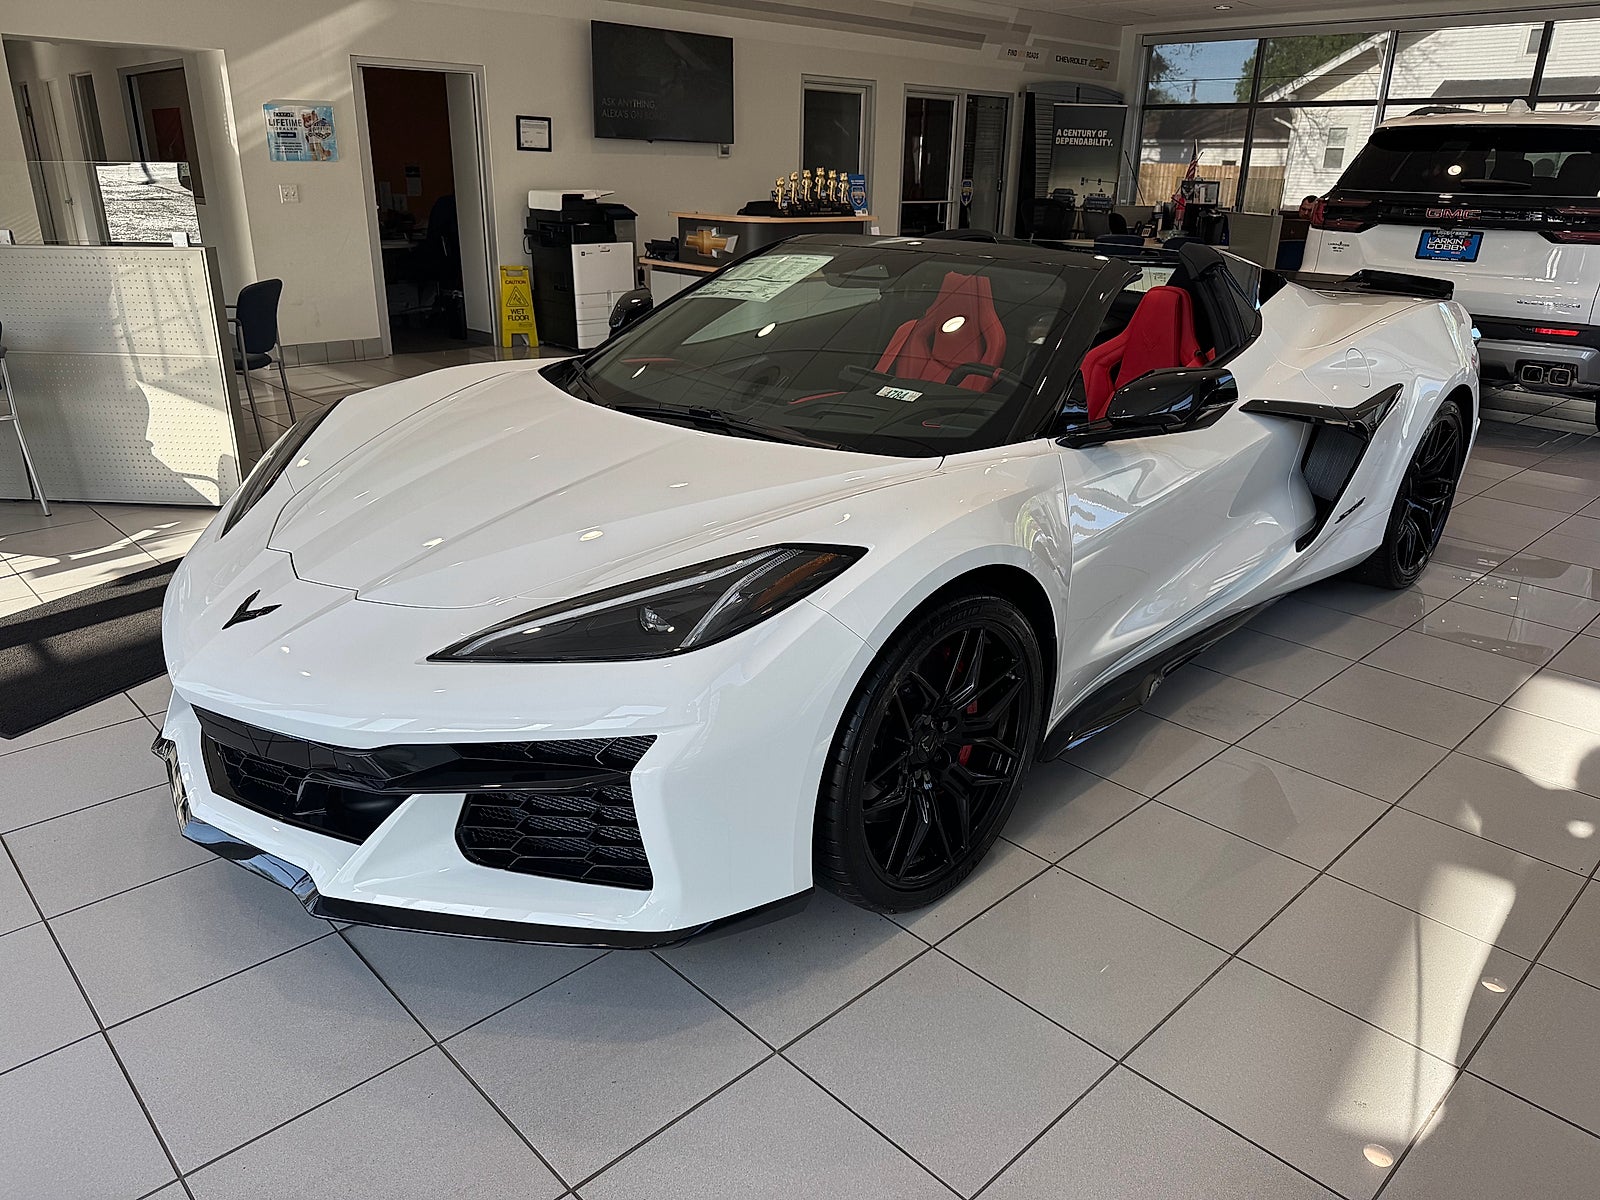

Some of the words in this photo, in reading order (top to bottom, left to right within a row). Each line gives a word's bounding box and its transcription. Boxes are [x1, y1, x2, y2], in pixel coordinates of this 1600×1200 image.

[1007, 48, 1017, 57] FIND
[1055, 55, 1088, 66] CHEVROLET
[602, 97, 615, 106] ASK
[268, 118, 302, 127] LIFETIME
[1056, 129, 1062, 137] A
[1063, 129, 1096, 137] CENTURY
[1097, 130, 1108, 138] OF
[1055, 137, 1114, 147] DEPENDABILITY.
[1425, 207, 1481, 219] GMC
[1428, 237, 1463, 245] LARKIN
